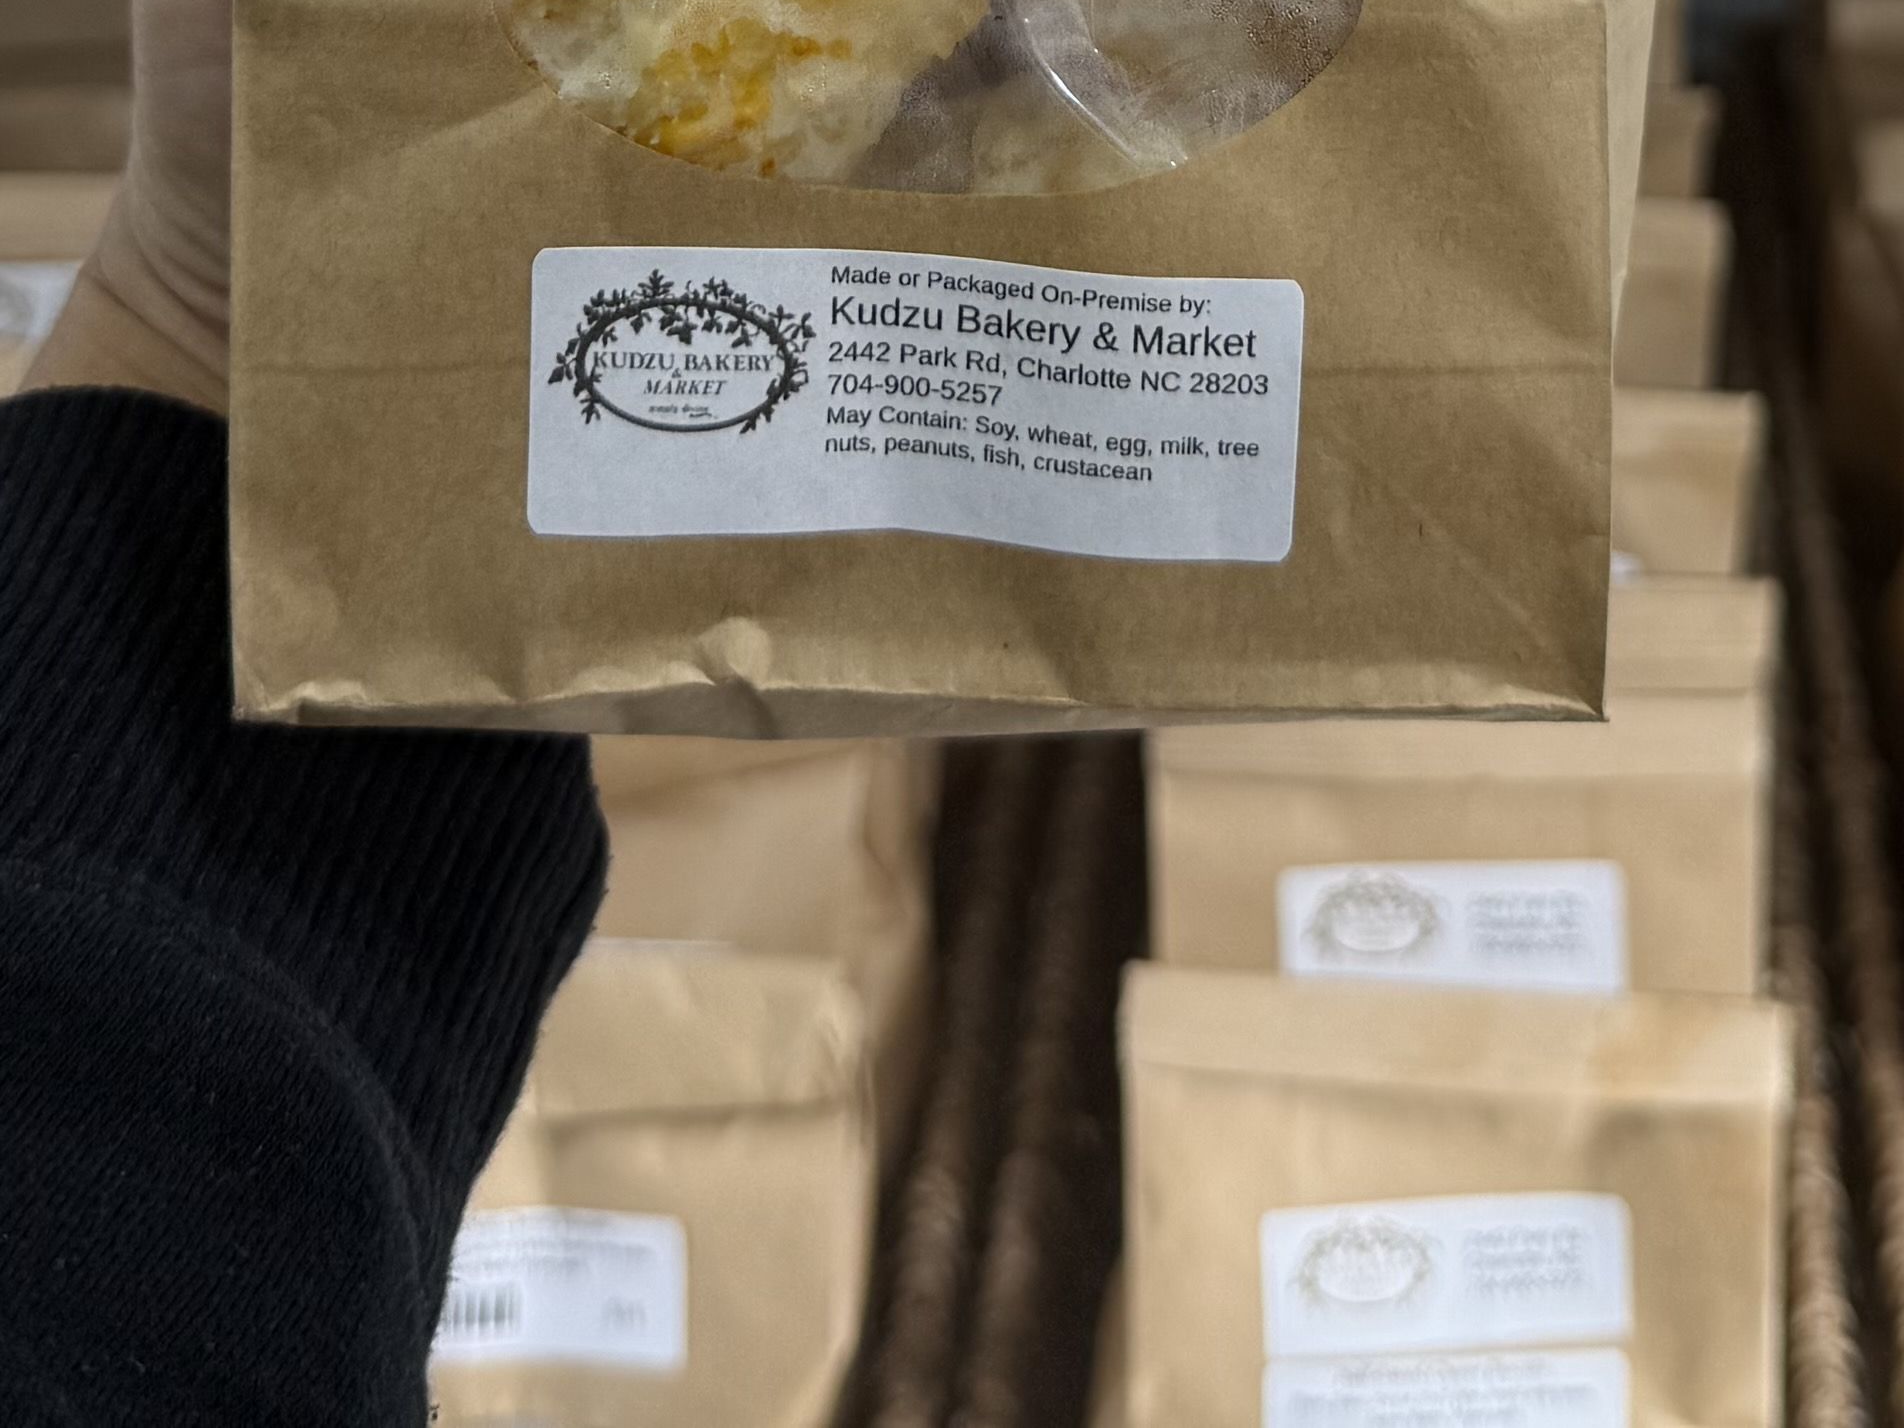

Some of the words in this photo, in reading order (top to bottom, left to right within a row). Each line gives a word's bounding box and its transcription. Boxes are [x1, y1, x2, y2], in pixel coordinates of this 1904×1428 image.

[831, 265, 892, 285] Made
[898, 272, 921, 288] or
[927, 271, 1034, 301] Packaged
[1040, 284, 1172, 313] On-Premise
[1179, 294, 1211, 319] by:
[831, 295, 943, 331] Kudzu
[957, 303, 1081, 355] Bakery
[1092, 321, 1120, 352] &
[1132, 324, 1257, 358] Market
[593, 350, 676, 371] KUDZU
[684, 353, 775, 373] BAKERY
[828, 341, 891, 363] 2442
[900, 343, 957, 368] Park
[965, 350, 1007, 379] Rd,
[1017, 356, 1132, 390] Charlotte
[1140, 370, 1181, 393] NC
[1189, 372, 1269, 396] 28203
[643, 379, 727, 396] MARKET
[828, 373, 1000, 406] 704-900-5257
[826, 406, 872, 429] May
[878, 405, 967, 431] Contain:
[975, 415, 1019, 442] Soy,
[1027, 424, 1098, 452] wheat,
[1105, 436, 1152, 458] egg,
[1160, 436, 1209, 458] milk,
[1217, 439, 1260, 458] tree
[825, 434, 876, 454] nuts,
[884, 436, 975, 463] peanuts,
[983, 443, 1025, 471] fish,
[1033, 449, 1153, 482] crustacean
